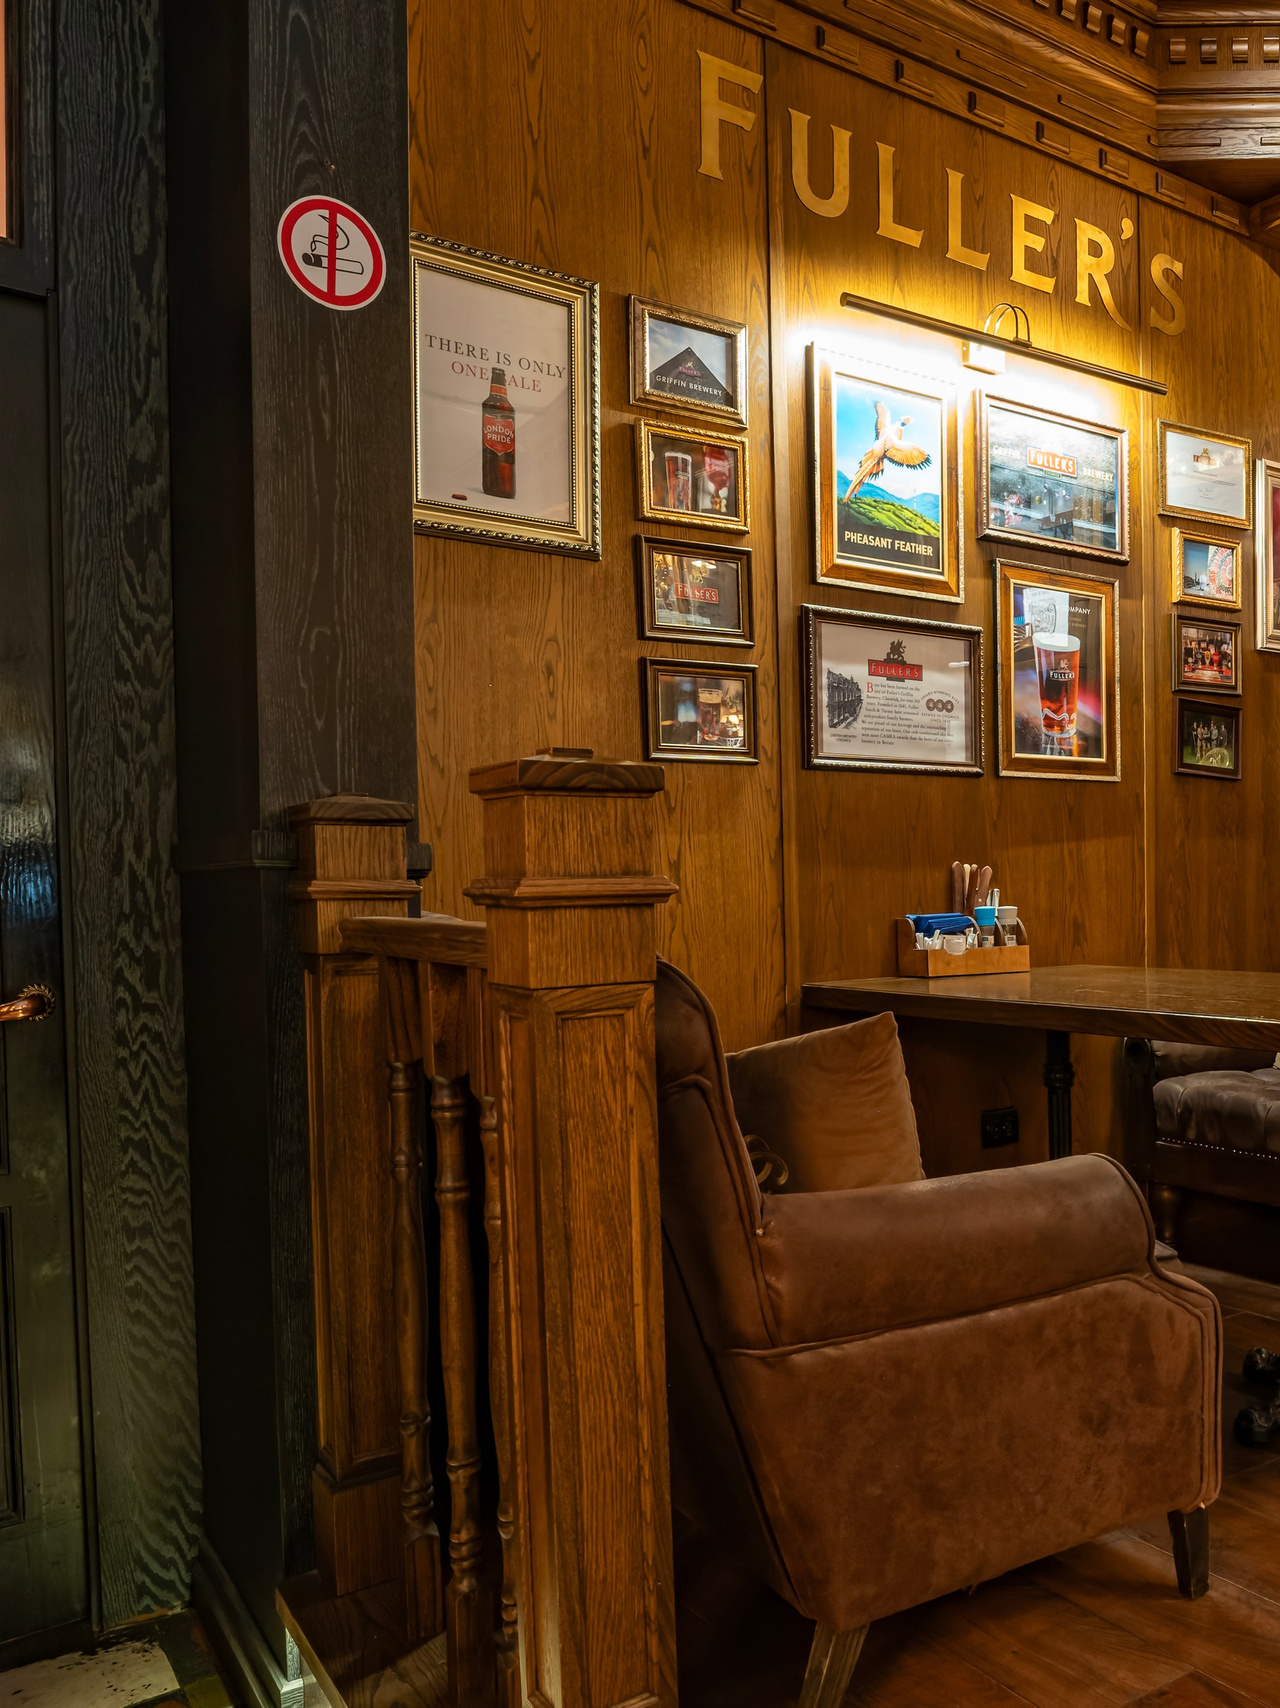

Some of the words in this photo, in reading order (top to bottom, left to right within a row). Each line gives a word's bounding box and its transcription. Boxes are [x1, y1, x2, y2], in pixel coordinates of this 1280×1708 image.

[696, 49, 1186, 336] FULLER'S
[425, 333, 490, 362] THERE
[496, 351, 511, 364] IS
[518, 357, 566, 379] ONLY
[451, 360, 488, 382] ONE
[508, 376, 542, 392] ALE
[656, 375, 686, 388] GRIFFIN
[690, 382, 722, 396] BREWERY
[484, 425, 514, 439] LONDON
[488, 433, 511, 444] PRIDE
[1030, 451, 1074, 472] FULLER'S
[844, 530, 892, 550] PHEASANT
[894, 540, 933, 557] FEATHER
